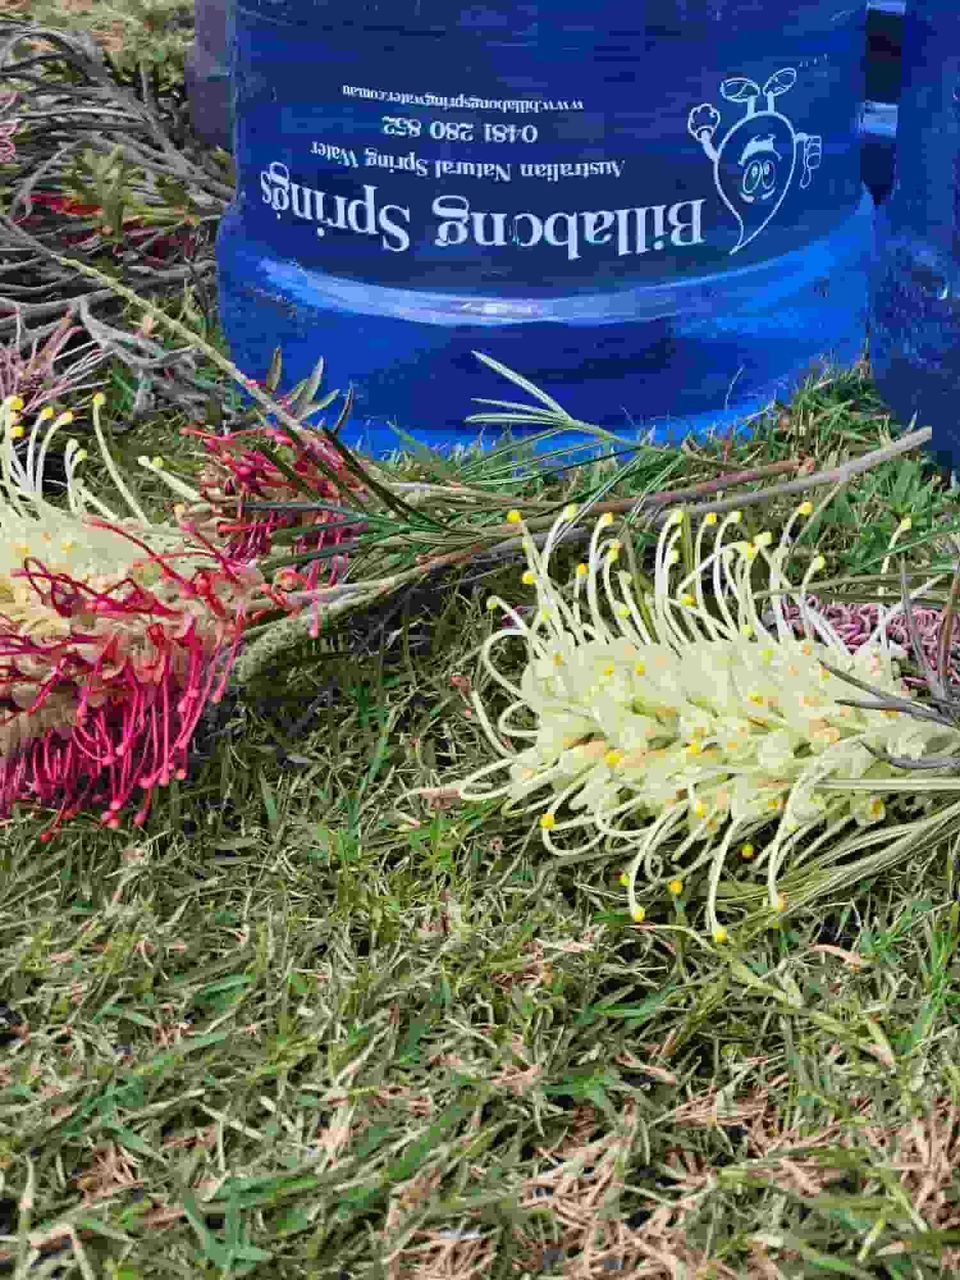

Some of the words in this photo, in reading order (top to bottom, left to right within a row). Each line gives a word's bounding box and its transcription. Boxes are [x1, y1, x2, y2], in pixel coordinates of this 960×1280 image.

[381, 115, 422, 137] 852
[430, 119, 474, 142] 280
[483, 122, 539, 144] 0481
[310, 141, 359, 168] Water
[364, 146, 428, 177] Spring
[435, 159, 512, 183] Natural
[521, 159, 626, 179] Australian
[260, 161, 411, 252] Springs
[432, 195, 707, 259] Billabong
